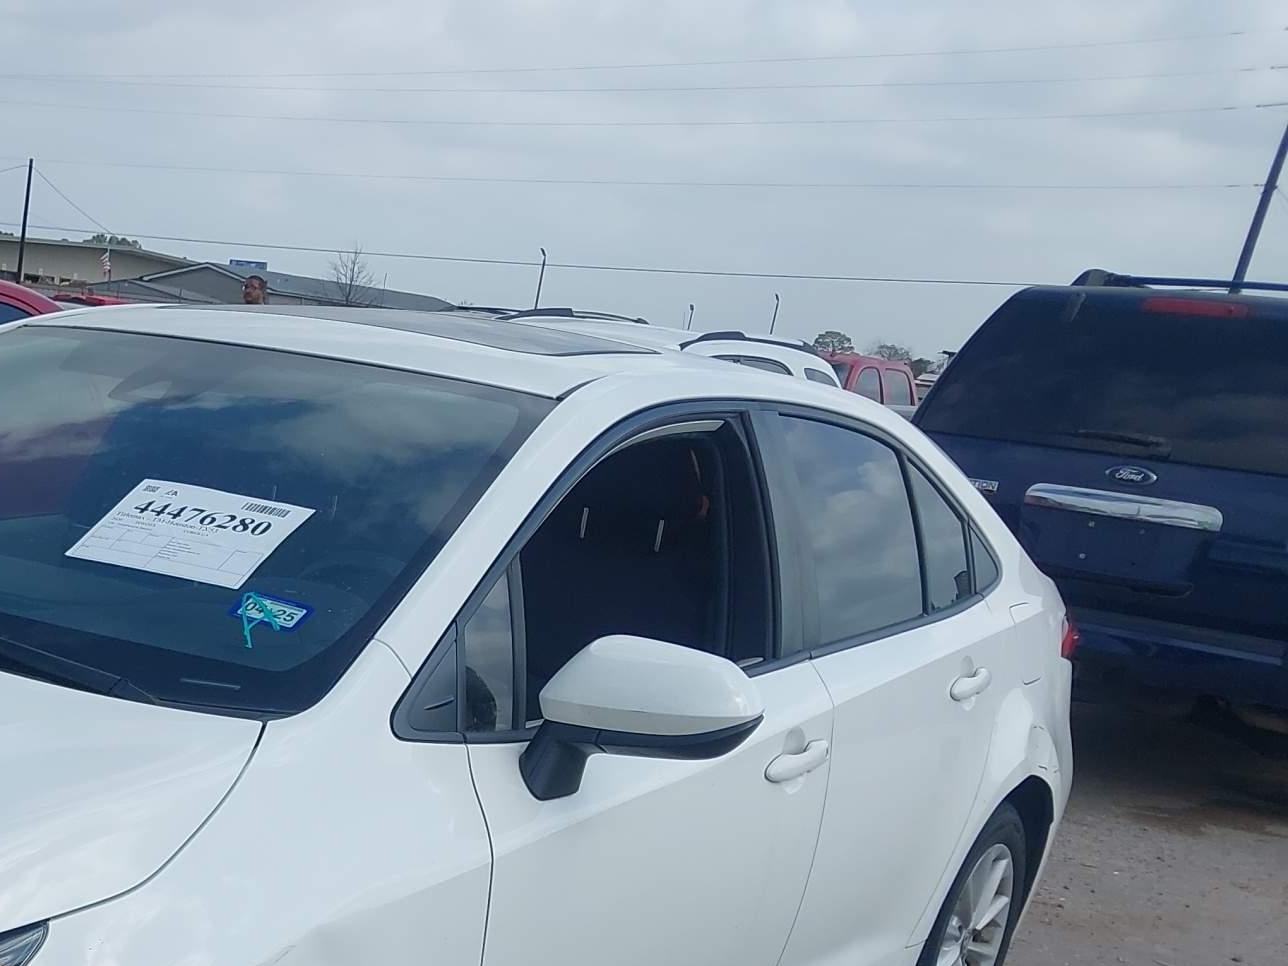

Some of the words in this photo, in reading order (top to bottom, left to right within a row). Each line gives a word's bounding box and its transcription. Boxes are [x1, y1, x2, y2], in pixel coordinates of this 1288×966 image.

[1114, 467, 1145, 482] Ford
[133, 500, 273, 536] 44476280
[273, 609, 299, 622] 25
